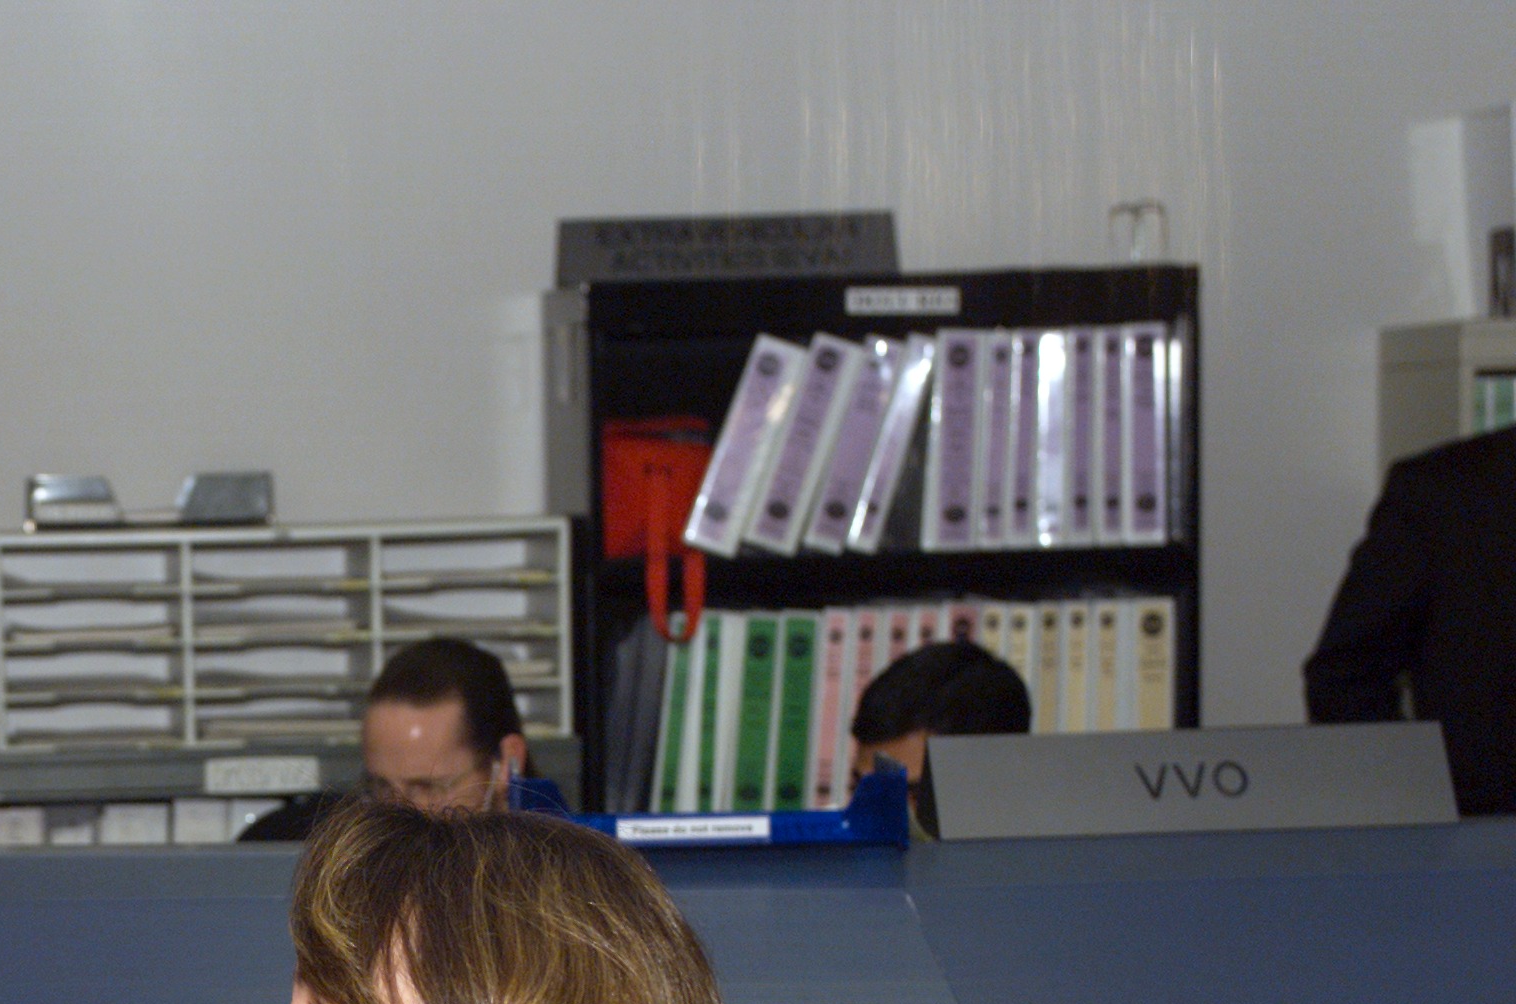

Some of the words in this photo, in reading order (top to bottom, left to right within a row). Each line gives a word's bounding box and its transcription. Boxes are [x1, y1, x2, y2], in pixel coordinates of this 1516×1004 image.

[1133, 760, 1249, 799] VVO
[632, 824, 669, 834] Please
[673, 823, 686, 833] do
[690, 823, 709, 832] not
[711, 822, 753, 832] remove
